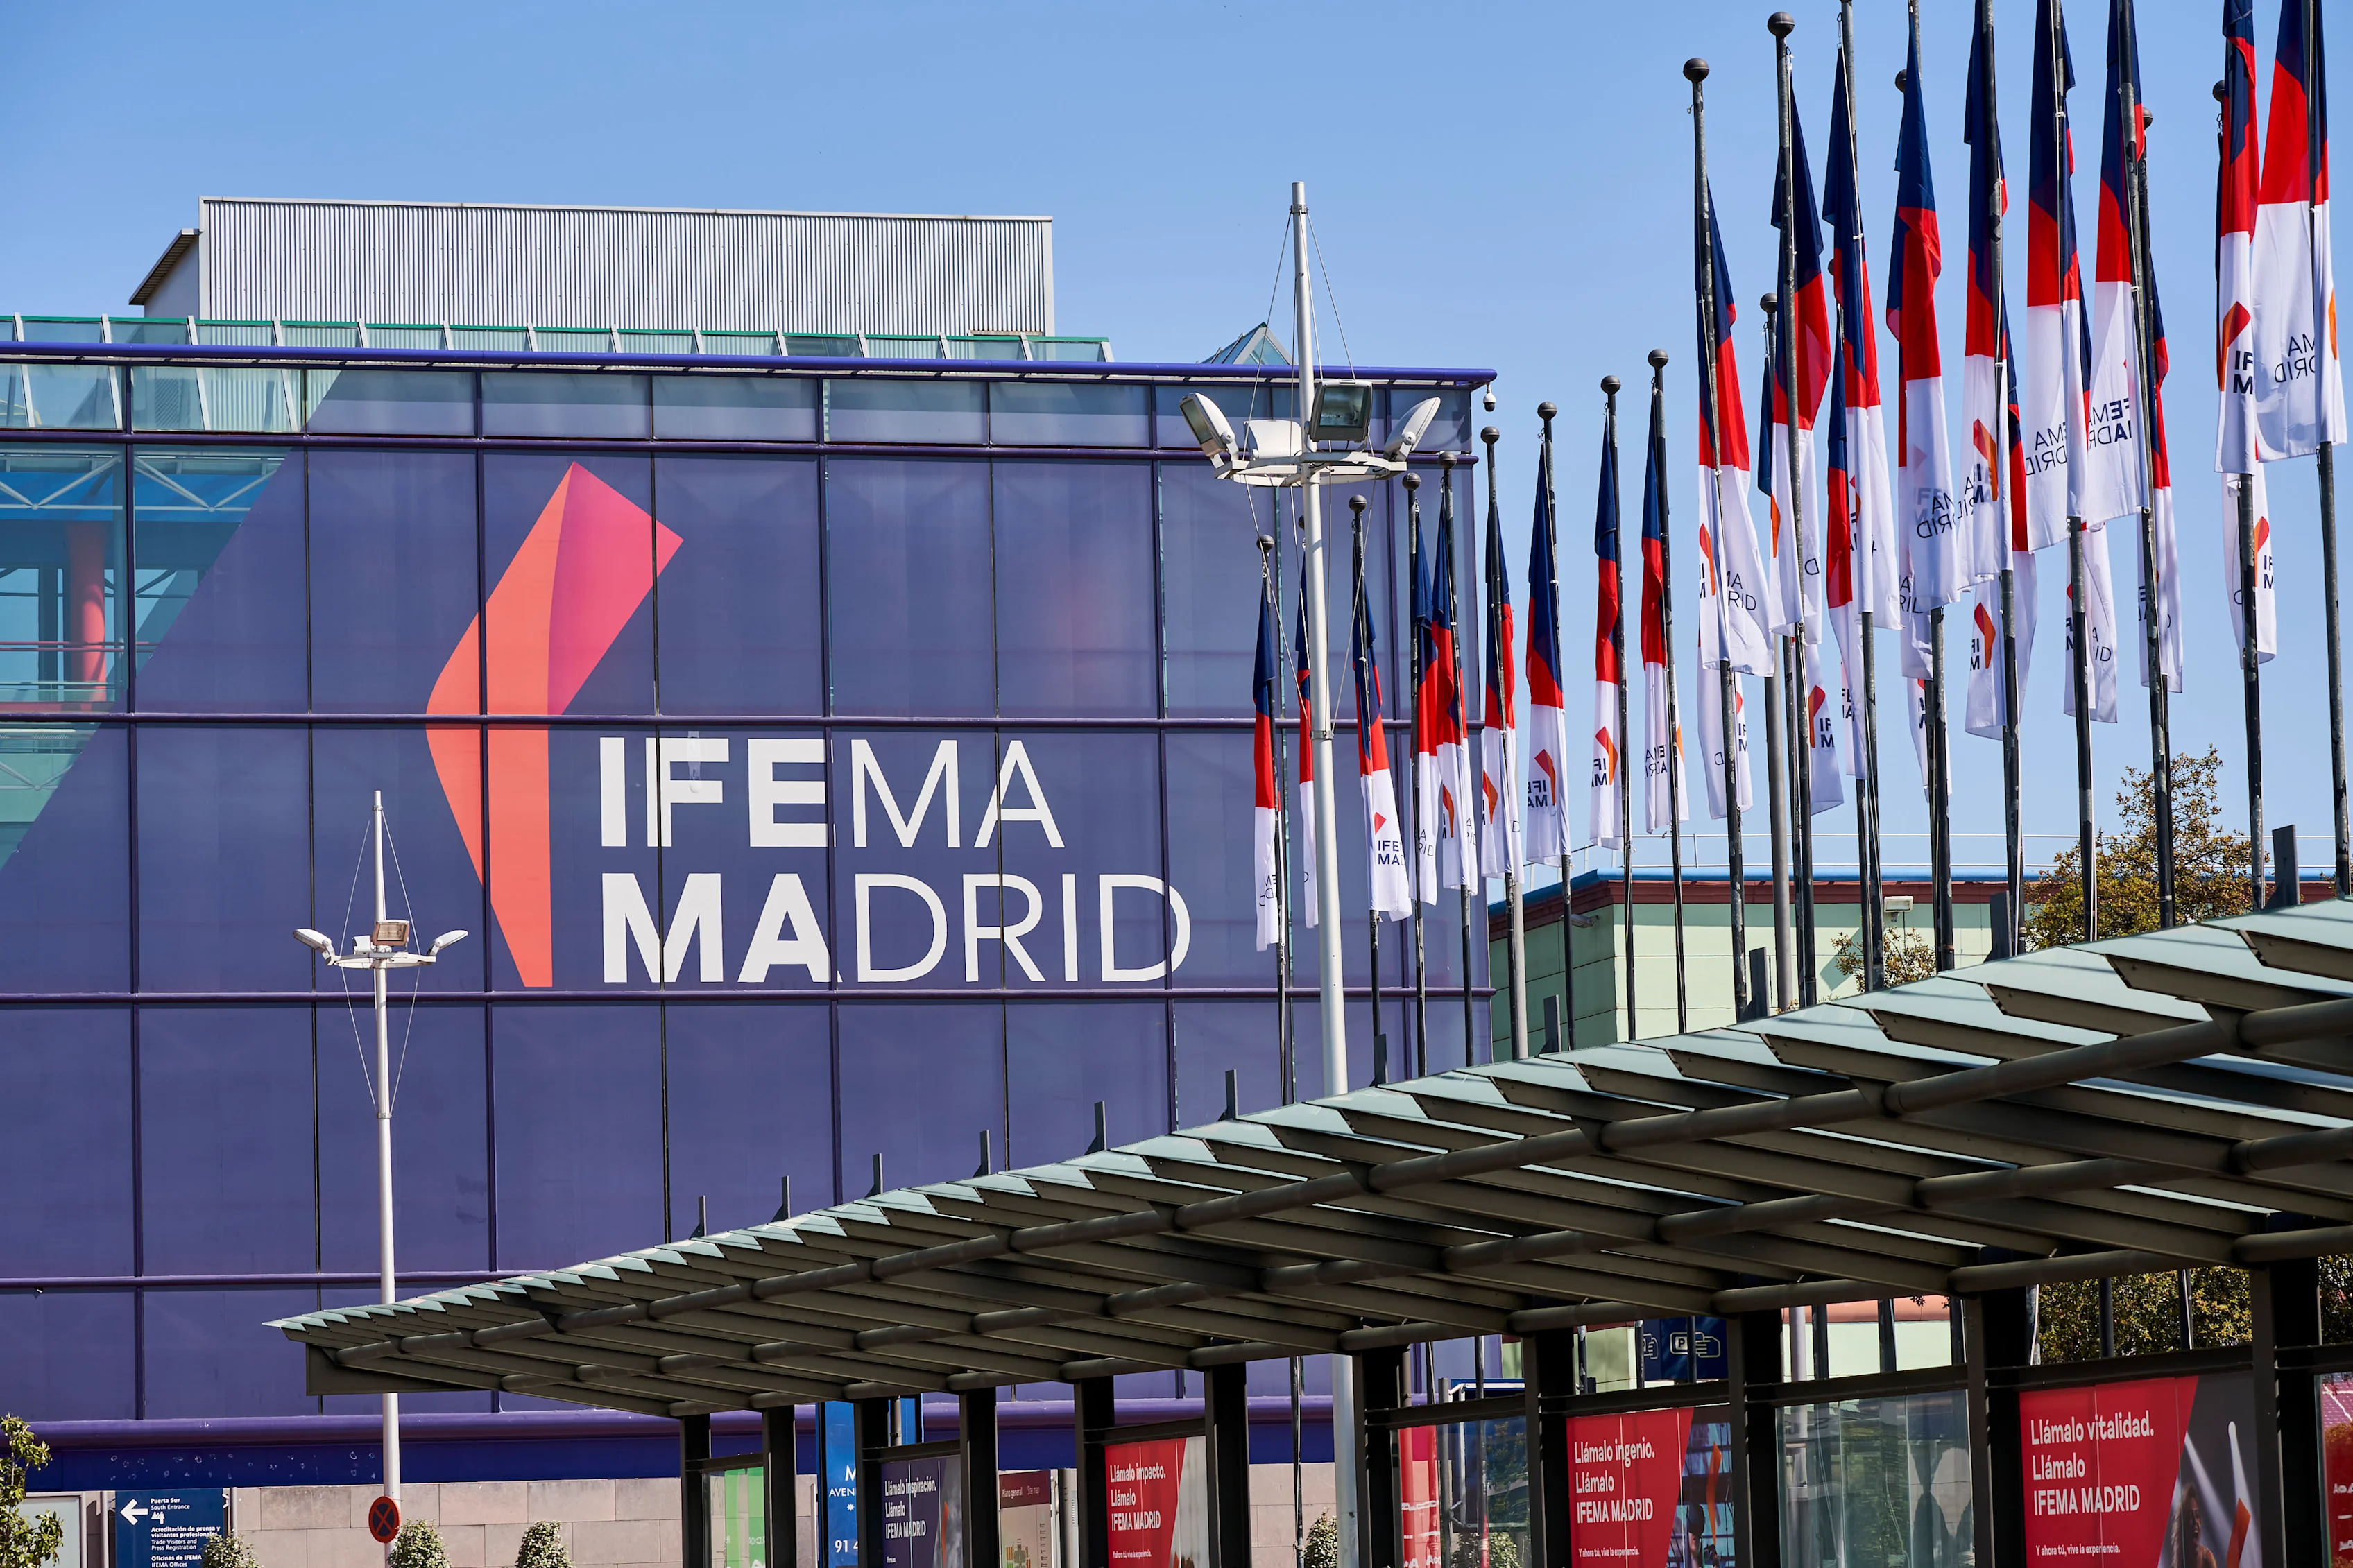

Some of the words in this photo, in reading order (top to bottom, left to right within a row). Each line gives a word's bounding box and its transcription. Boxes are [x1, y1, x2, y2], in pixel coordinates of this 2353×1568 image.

[599, 737, 1065, 848] IFEMA
[1378, 840, 1402, 852] IFE
[601, 873, 1191, 983] MADRID
[2030, 1416, 2084, 1445] Llámalo
[2087, 1410, 2155, 1441] vitalidad.
[1574, 1439, 1614, 1464] Llámalo
[1615, 1436, 1655, 1468] ingenio.
[1110, 1463, 1135, 1483] Llámalo
[1136, 1462, 1166, 1485] impacto.
[2032, 1452, 2086, 1481] Llámalo
[828, 1488, 857, 1497] AVEN
[884, 1479, 905, 1497] Llámalo
[905, 1476, 936, 1498] inspiración.
[1575, 1470, 1615, 1494] Llámalo
[1111, 1488, 1136, 1507] Llámalo
[2033, 1488, 2078, 1516] IFEMA
[2081, 1485, 2141, 1514] MADRID
[885, 1501, 905, 1518] Llámalo
[1111, 1513, 1133, 1531] IFEMA
[1133, 1510, 1161, 1530] MADRID
[1577, 1501, 1609, 1524] IFEMA
[1611, 1498, 1653, 1522] MADRID
[886, 1522, 903, 1539] IFEMA
[903, 1520, 926, 1537] MADRID
[835, 1540, 848, 1553] 91
[1578, 1548, 1582, 1558] Y
[1582, 1548, 1594, 1558] ahora
[1601, 1547, 1609, 1556] vive
[1610, 1547, 1614, 1556] la
[1614, 1546, 1640, 1558] experiencia.
[2036, 1545, 2040, 1556] Y
[2042, 1544, 2057, 1556] ahora
[2057, 1544, 2067, 1557] tú,
[2067, 1543, 2079, 1554] vive
[2080, 1542, 2085, 1554] la
[2085, 1542, 2121, 1557] experiencia.
